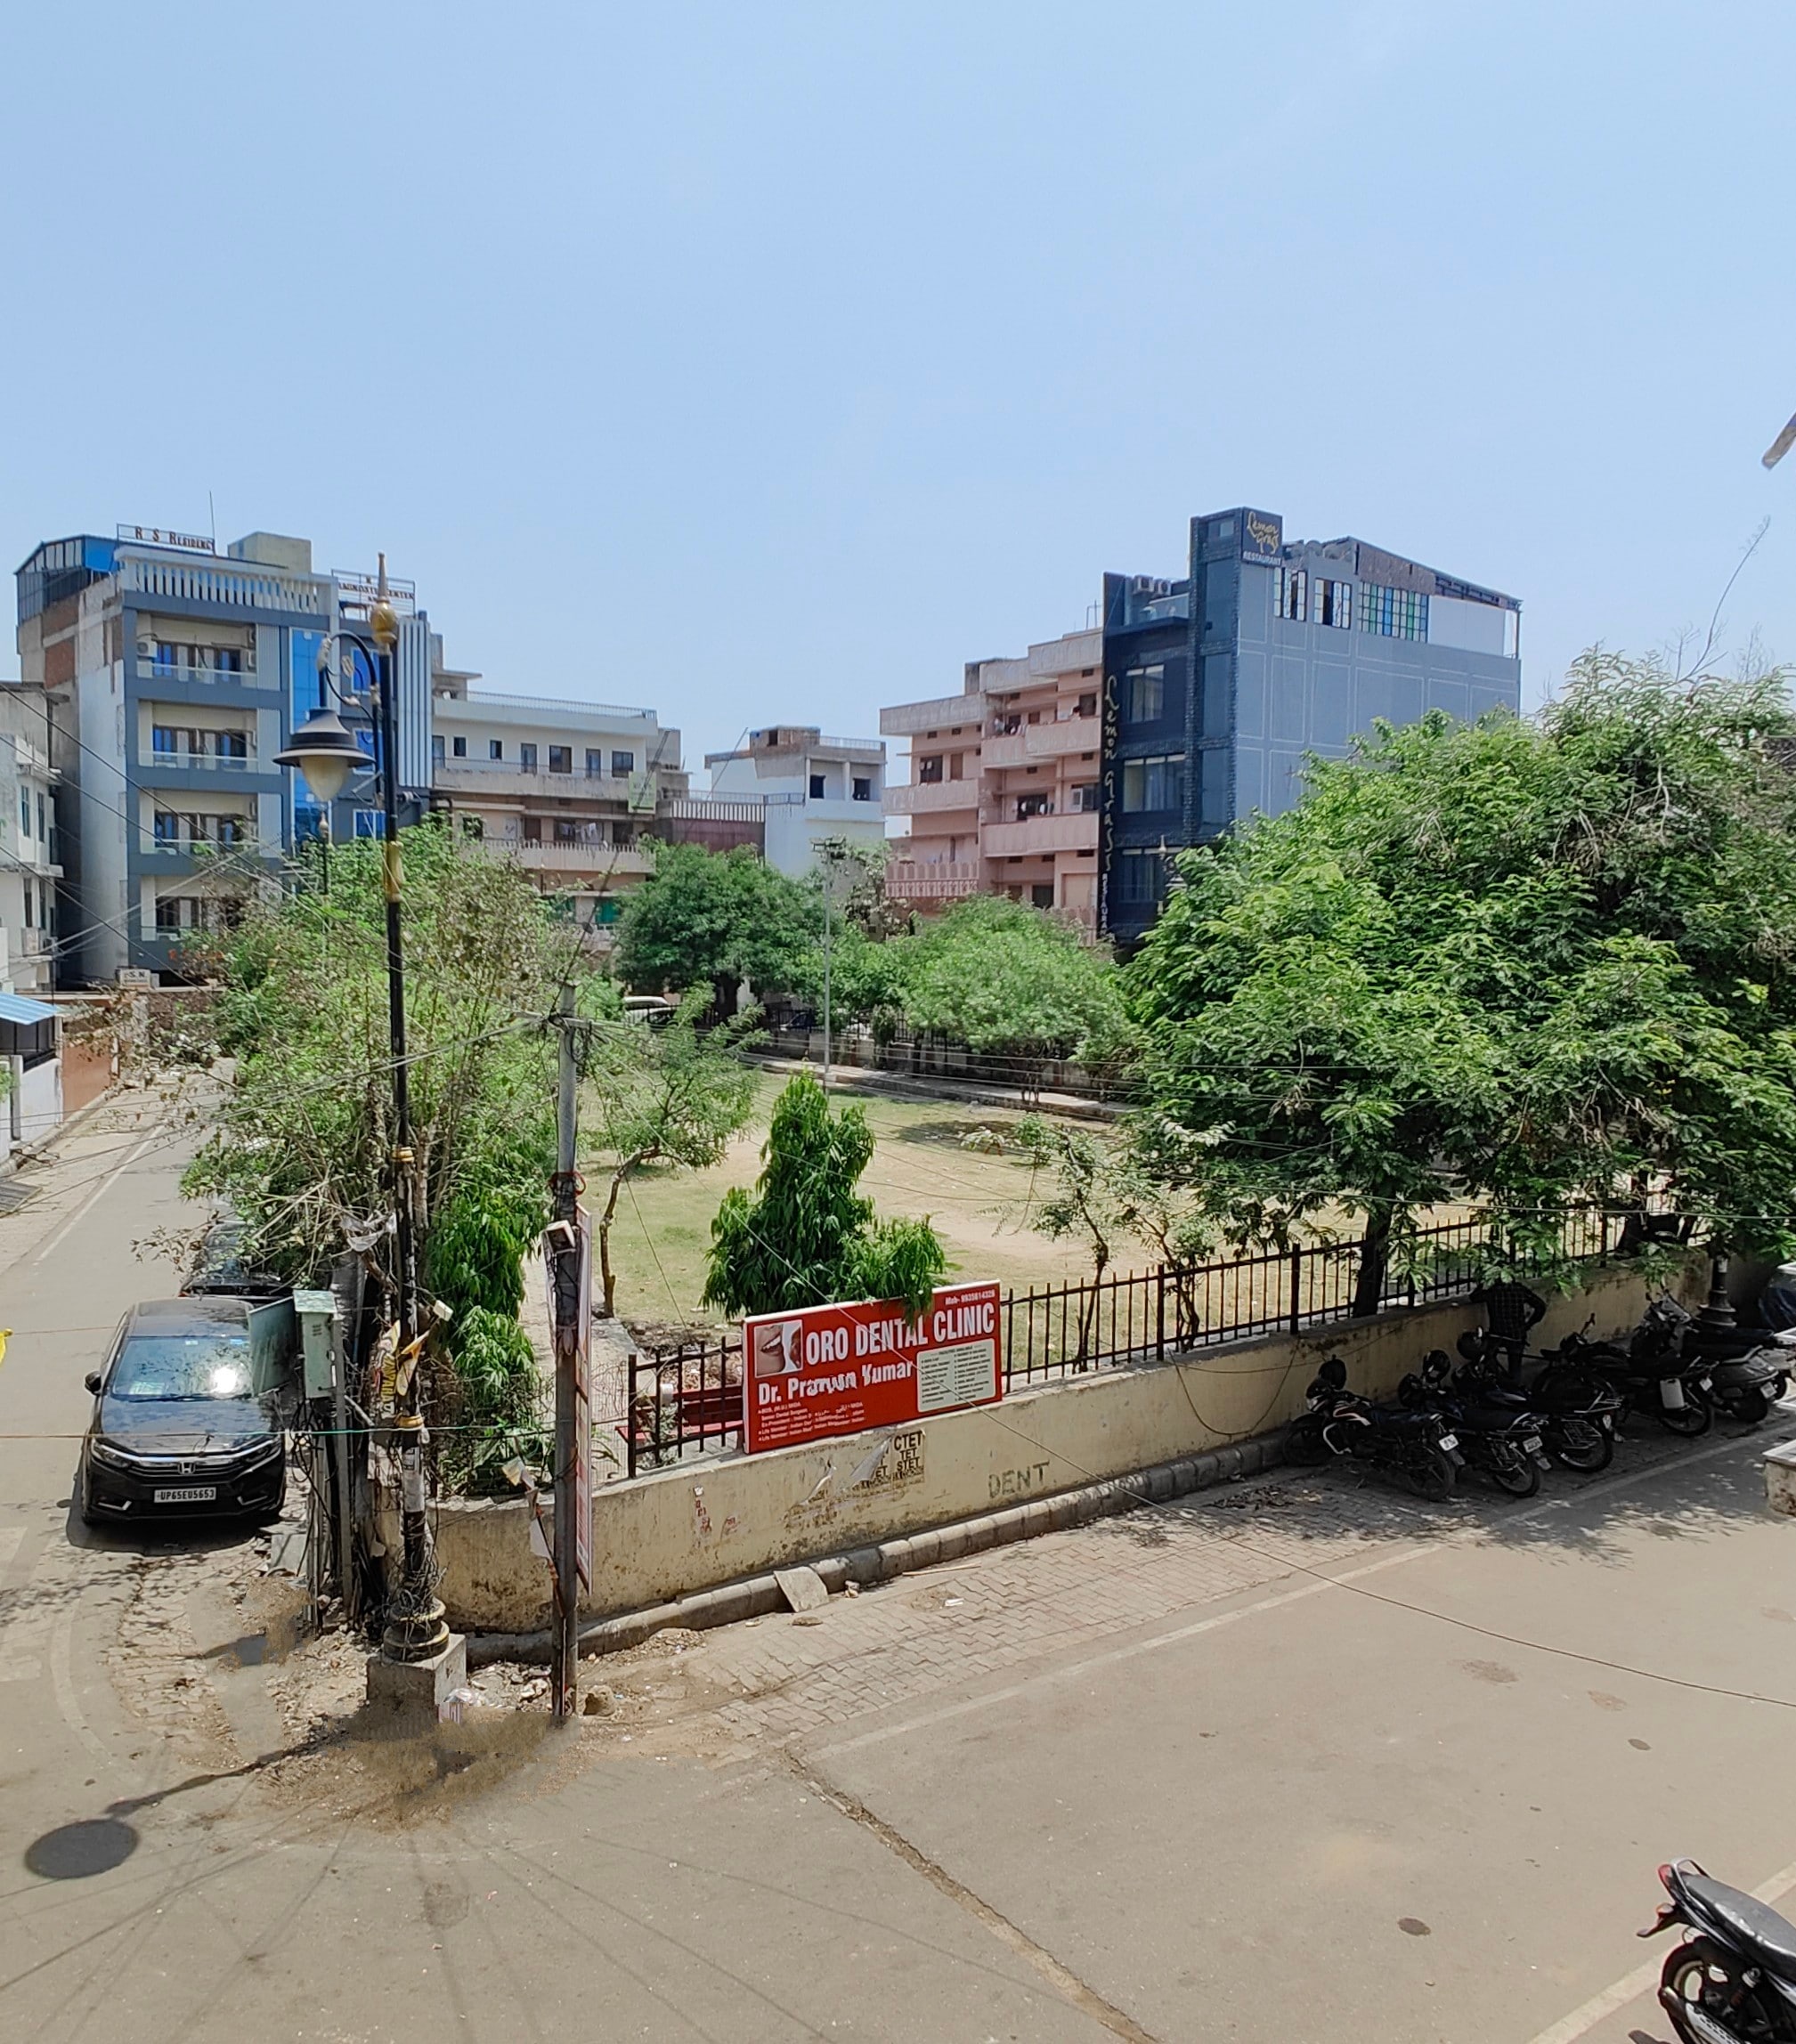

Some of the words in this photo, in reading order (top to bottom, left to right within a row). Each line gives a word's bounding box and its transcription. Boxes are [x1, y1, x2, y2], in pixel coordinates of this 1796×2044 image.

[134, 526, 142, 539] R
[152, 528, 159, 542] S
[1243, 550, 1281, 566] RESTAURANT
[1104, 675, 1120, 760] Lemon
[806, 1326, 849, 1365] ORO
[856, 1315, 928, 1356] DENTAL
[933, 1302, 995, 1342] CLINIC
[758, 1383, 782, 1406] Dr.
[862, 1360, 914, 1387] Kumar
[894, 1431, 922, 1450] CTET
[899, 1447, 917, 1460] TET
[897, 1456, 920, 1472] STET
[988, 1459, 1051, 1498] DENT
